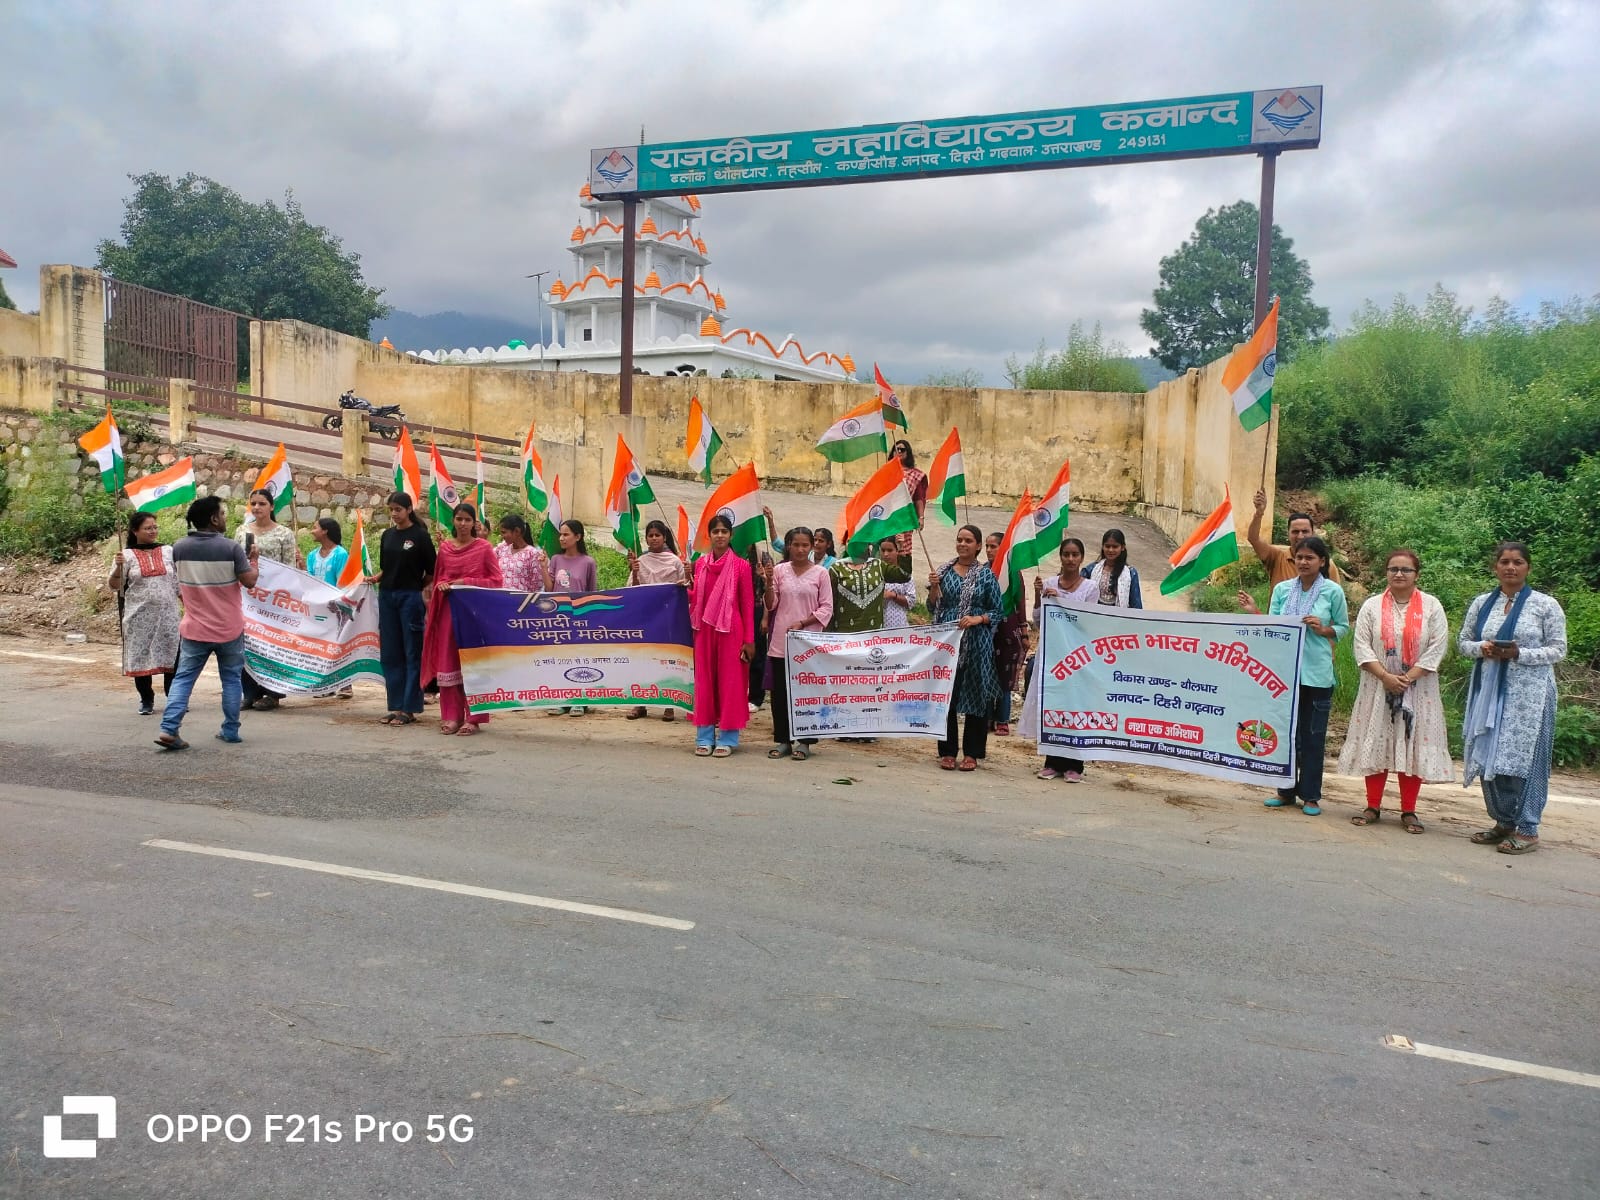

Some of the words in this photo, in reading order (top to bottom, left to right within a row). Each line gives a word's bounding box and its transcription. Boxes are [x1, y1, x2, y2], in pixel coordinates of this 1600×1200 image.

[650, 137, 793, 169] राजकीय
[812, 114, 1076, 157] महाविद्यालय
[1100, 100, 1239, 132] कमान्द
[950, 147, 985, 164] टिहरी
[1041, 140, 1102, 155] उत्तराखण्ड
[1118, 133, 1166, 150] 249131
[281, 615, 301, 628] 2022
[507, 614, 570, 630] आज़ादी
[573, 619, 588, 628] का
[528, 629, 572, 644] अमृत
[576, 626, 644, 640] महोत्सव
[909, 634, 932, 646] टिहरी
[1050, 645, 1092, 681] नशा
[1091, 634, 1140, 664] मुक्त
[1145, 634, 1200, 653] भारत
[1204, 641, 1288, 699] अभियान
[896, 670, 930, 683] साक्षरता
[1113, 670, 1145, 684] विकास
[466, 688, 514, 705] राजकीय
[518, 685, 582, 702] महाविद्यालय
[631, 684, 660, 699] टिहरी
[795, 697, 821, 707] आपका
[823, 692, 847, 705] हार्दिक
[891, 689, 930, 702] अभिनन्दन
[1154, 693, 1182, 709] टिहरी
[1184, 701, 1225, 716] गढ़वाल
[1128, 721, 1146, 733] नशा
[1148, 723, 1163, 735] एक
[1164, 724, 1199, 741] अभिशाप
[1240, 733, 1249, 741] NO
[1084, 737, 1103, 746] समाज
[1129, 739, 1151, 751] विभाग
